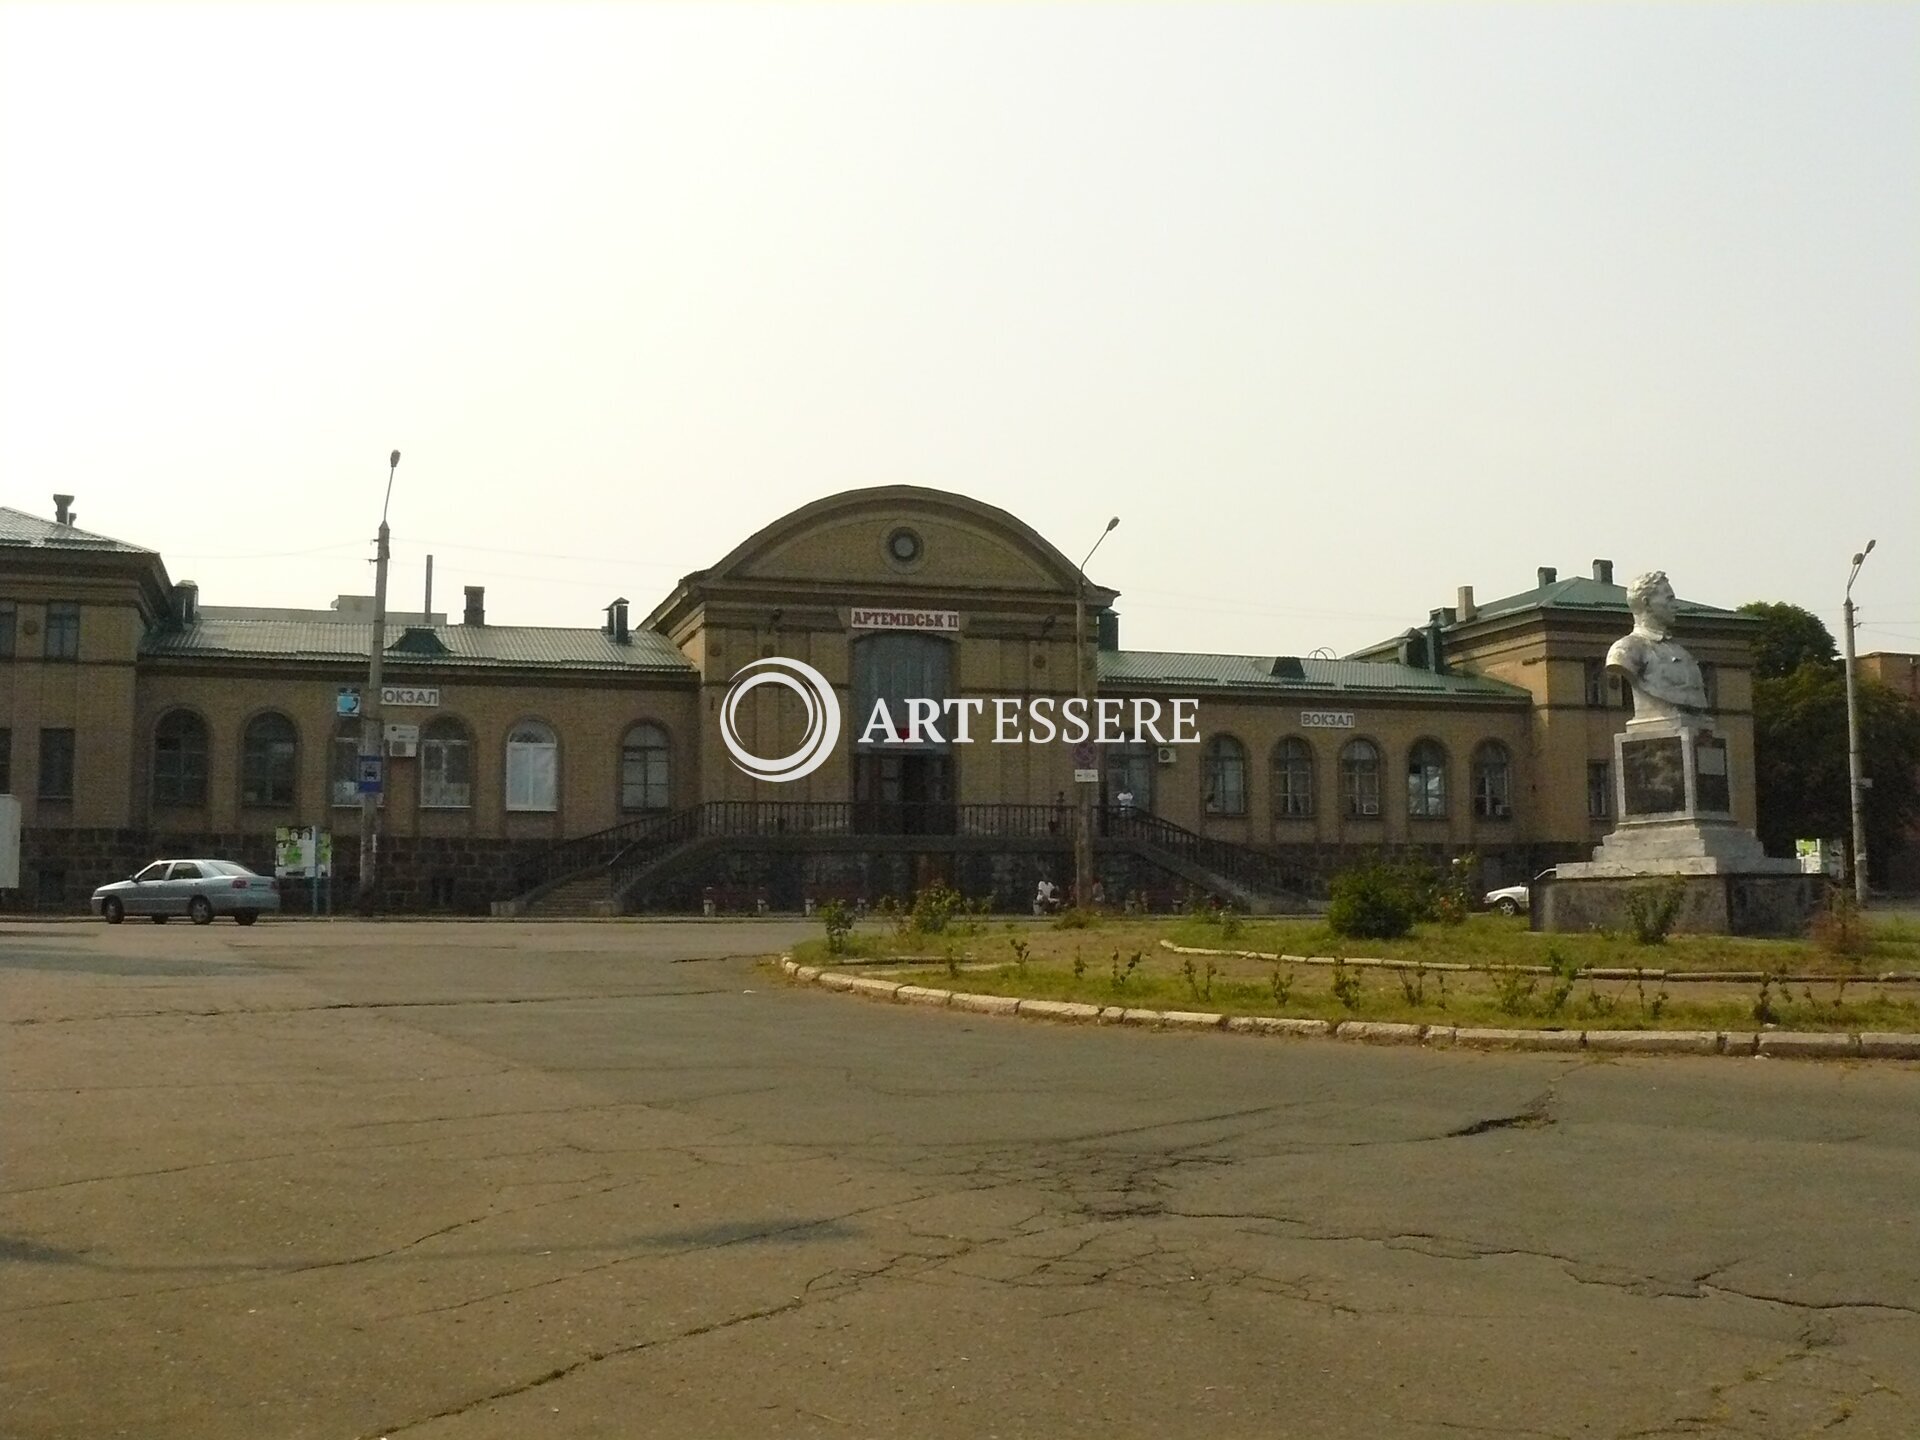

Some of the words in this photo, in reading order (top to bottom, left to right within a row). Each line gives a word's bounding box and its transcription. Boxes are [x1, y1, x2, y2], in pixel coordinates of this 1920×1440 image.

[852, 611, 944, 628] АРТЕМІВСЬК
[383, 690, 438, 704] ОКЗАЛ
[1302, 713, 1354, 726] ВОКЗАЛ
